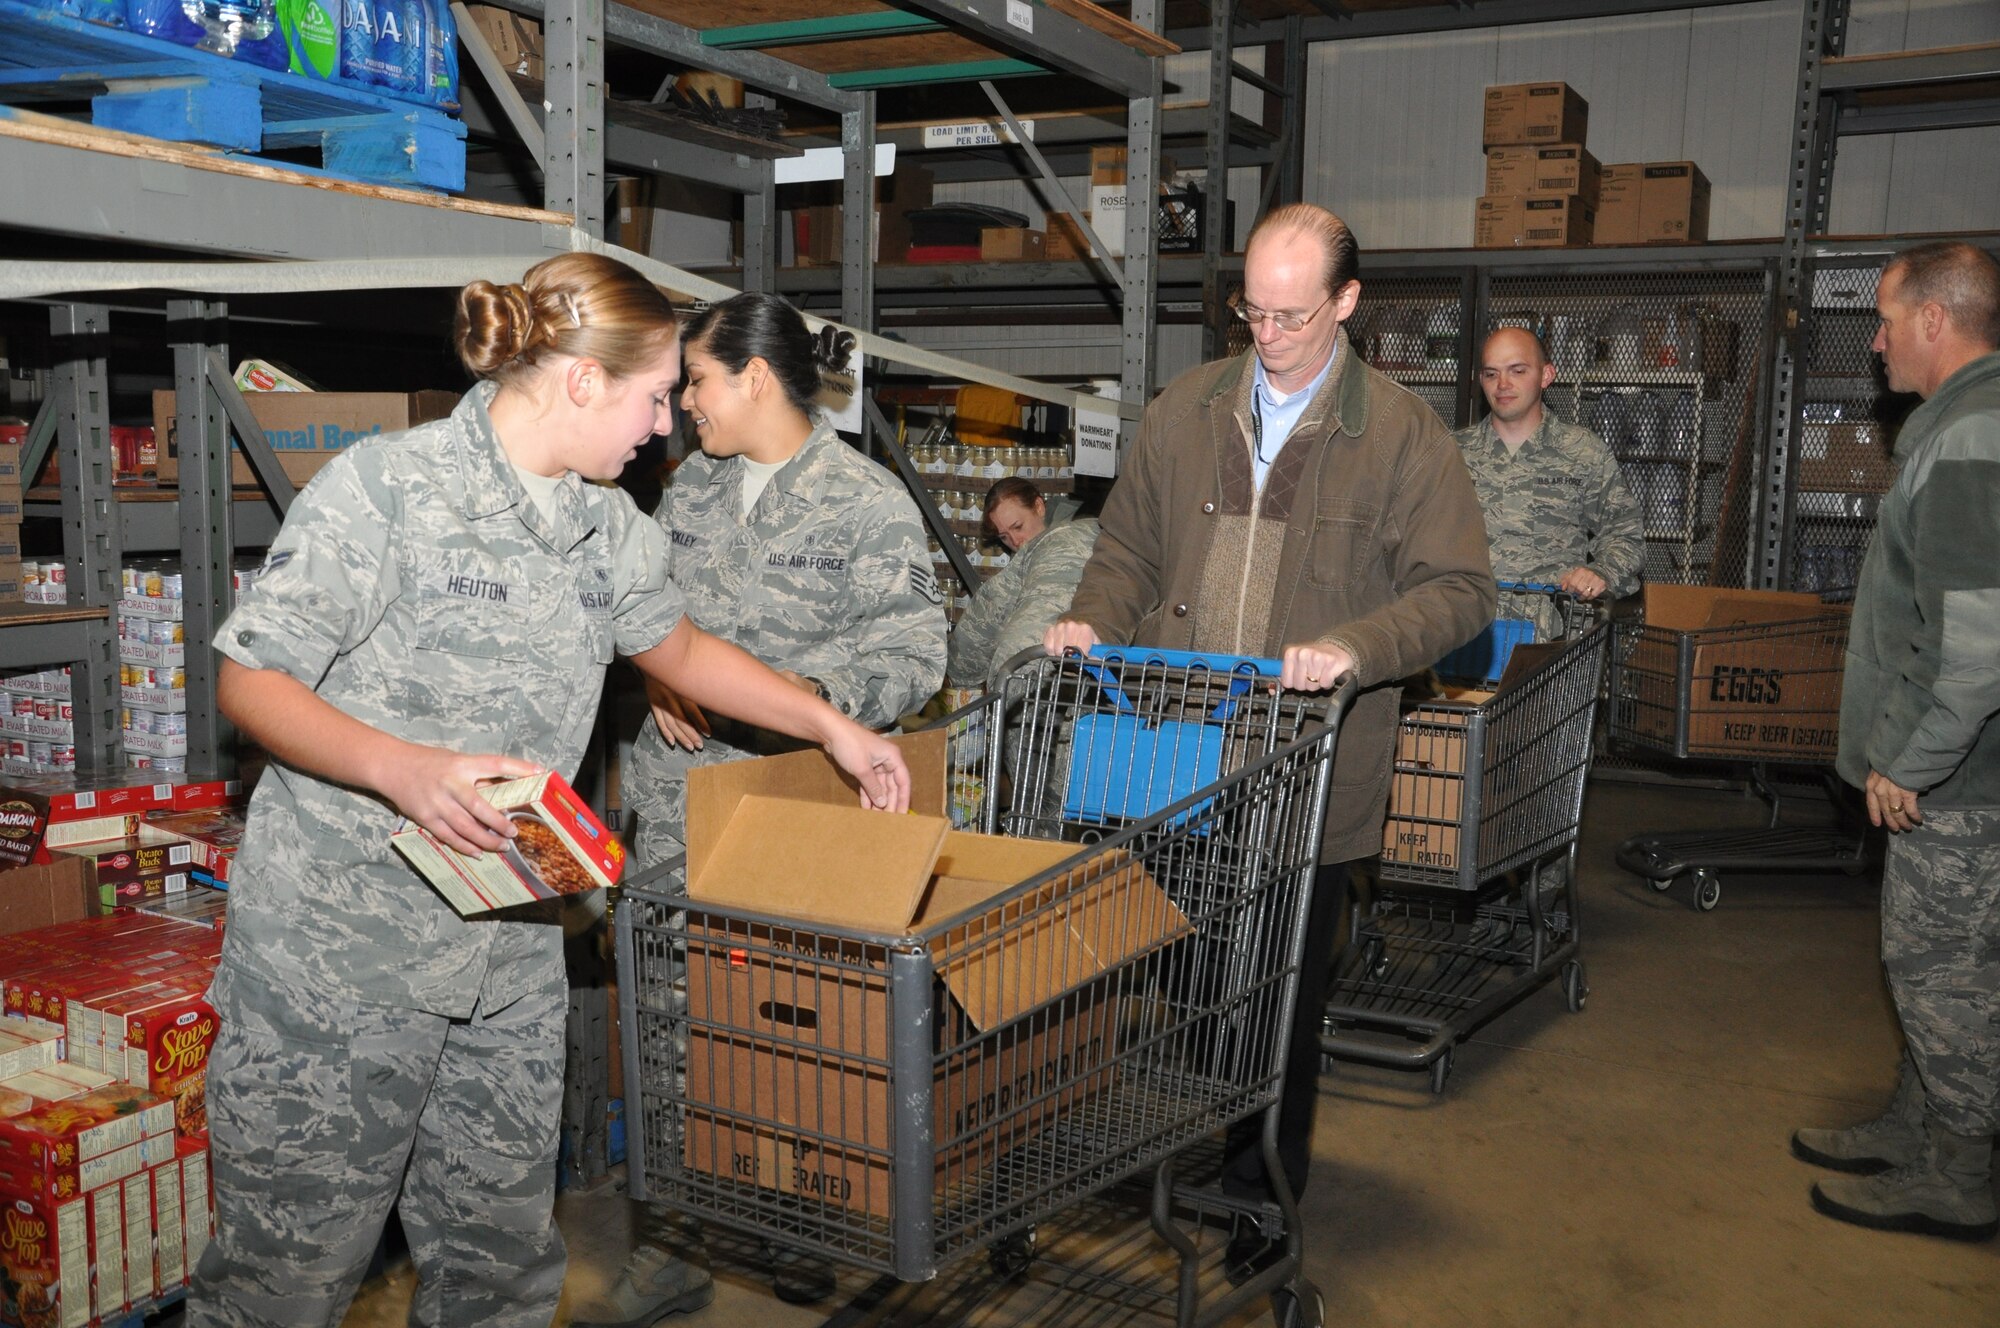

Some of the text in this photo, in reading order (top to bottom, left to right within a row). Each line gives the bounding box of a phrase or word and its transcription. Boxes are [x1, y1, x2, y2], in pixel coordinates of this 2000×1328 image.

[343, 0, 420, 48] DASANI
[932, 123, 1007, 136] LOAD LIMIT 8,0
[956, 137, 972, 145] PER
[1079, 424, 1114, 438] WARMHEART
[1081, 437, 1112, 451] DONATIONS
[672, 530, 697, 548] CKLEY
[788, 555, 806, 569] AIR
[809, 556, 845, 571] FORCE
[447, 574, 508, 603] HEUTON
[158, 602, 174, 614] MILK
[8, 679, 69, 693] EVAPORATED MILK
[1711, 665, 1782, 704] EGGS
[149, 694, 167, 704] MILK
[7, 721, 68, 737] EVAPORATED MILK
[1725, 722, 1838, 748] KEEP REFRIGERATE
[147, 739, 163, 750] MILK
[0, 812, 36, 827] DAHOAN
[7, 840, 31, 852] BAKED
[1399, 833, 1427, 847] KEEP
[136, 849, 163, 860] Potato
[139, 857, 160, 868] Buds
[179, 1013, 195, 1025] Kraft
[155, 1019, 213, 1073] Stove
[175, 1044, 206, 1077] Top
[174, 1070, 207, 1092] CHICKEN
[792, 1140, 811, 1162] EP
[2, 1208, 47, 1249] Stove
[16, 1239, 41, 1266] Top
[15, 1271, 44, 1281] CHICKEN
